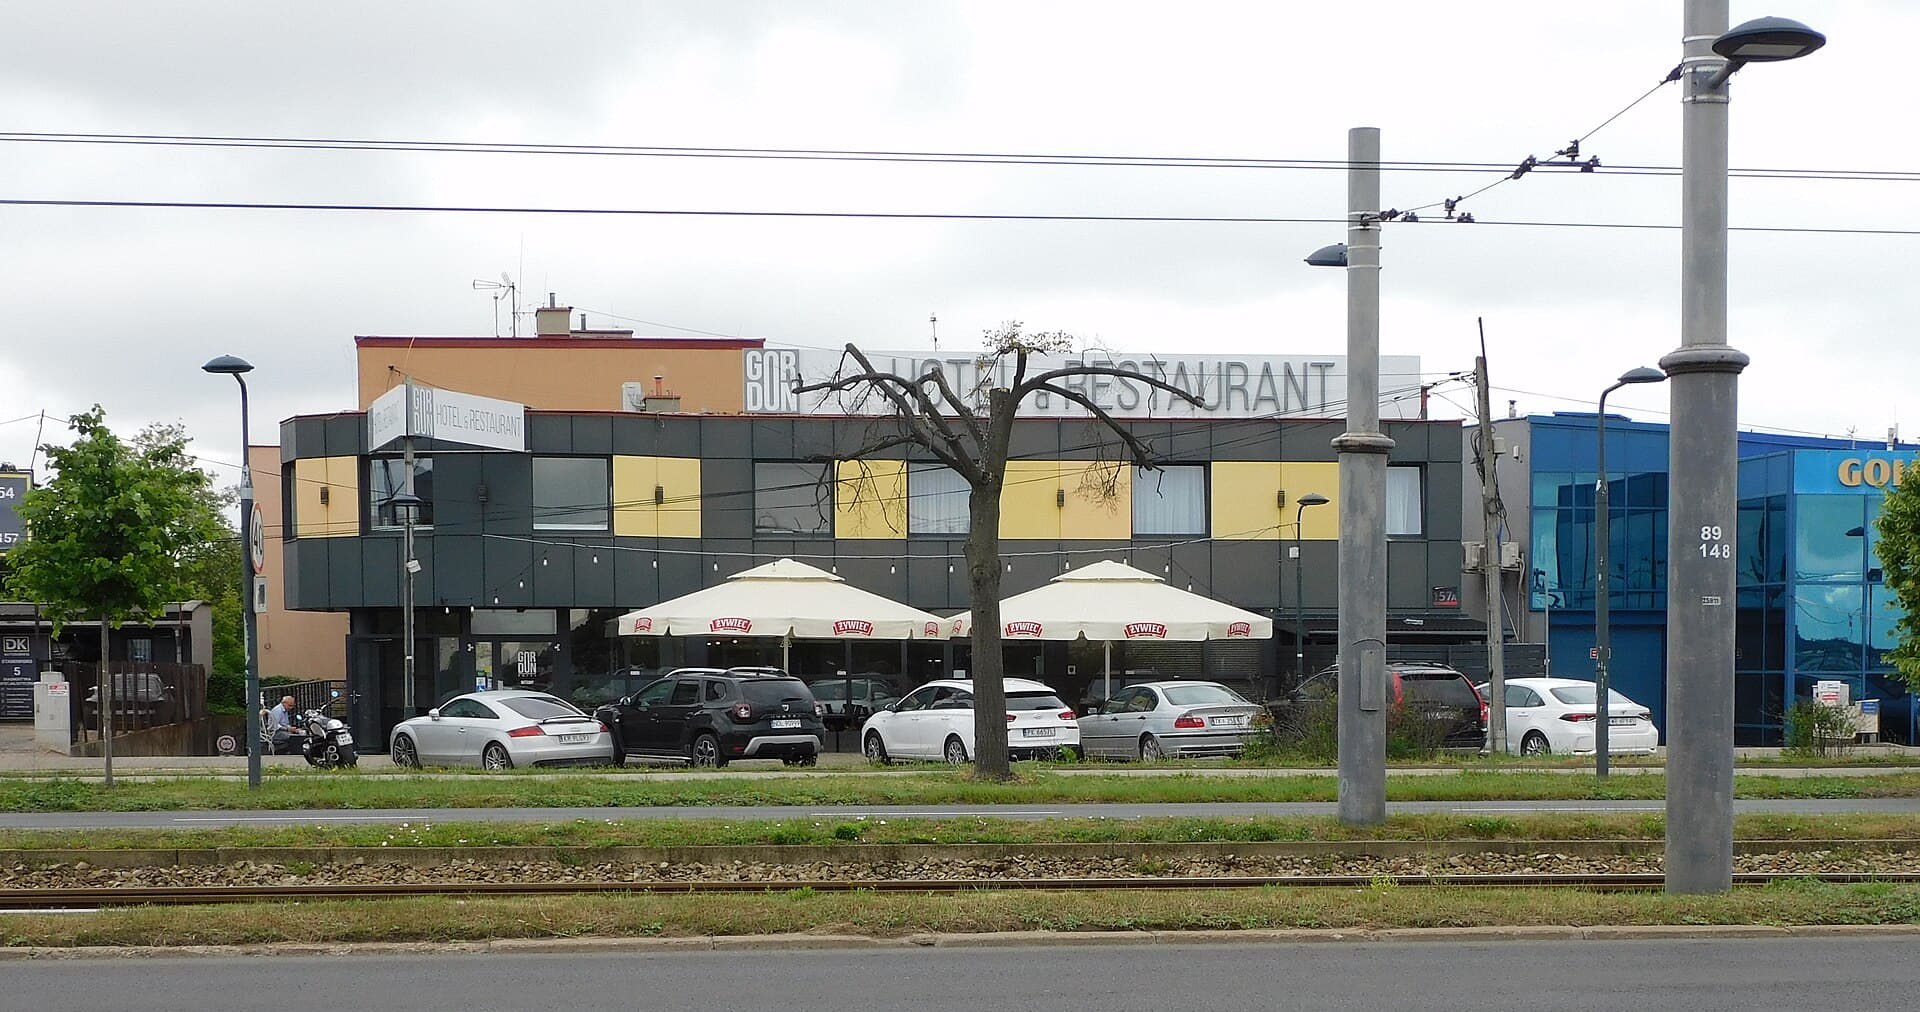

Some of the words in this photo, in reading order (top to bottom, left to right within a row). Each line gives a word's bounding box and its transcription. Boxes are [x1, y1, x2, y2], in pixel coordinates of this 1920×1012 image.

[1064, 360, 1335, 412] RESTAURANT
[435, 402, 462, 428] HOTEL
[470, 408, 520, 438] RESTAURANT
[1838, 458, 1920, 486] GO
[1701, 526, 1721, 540] 89
[1700, 543, 1730, 558] 148
[5, 638, 27, 650] DK
[13, 666, 21, 676] 5
